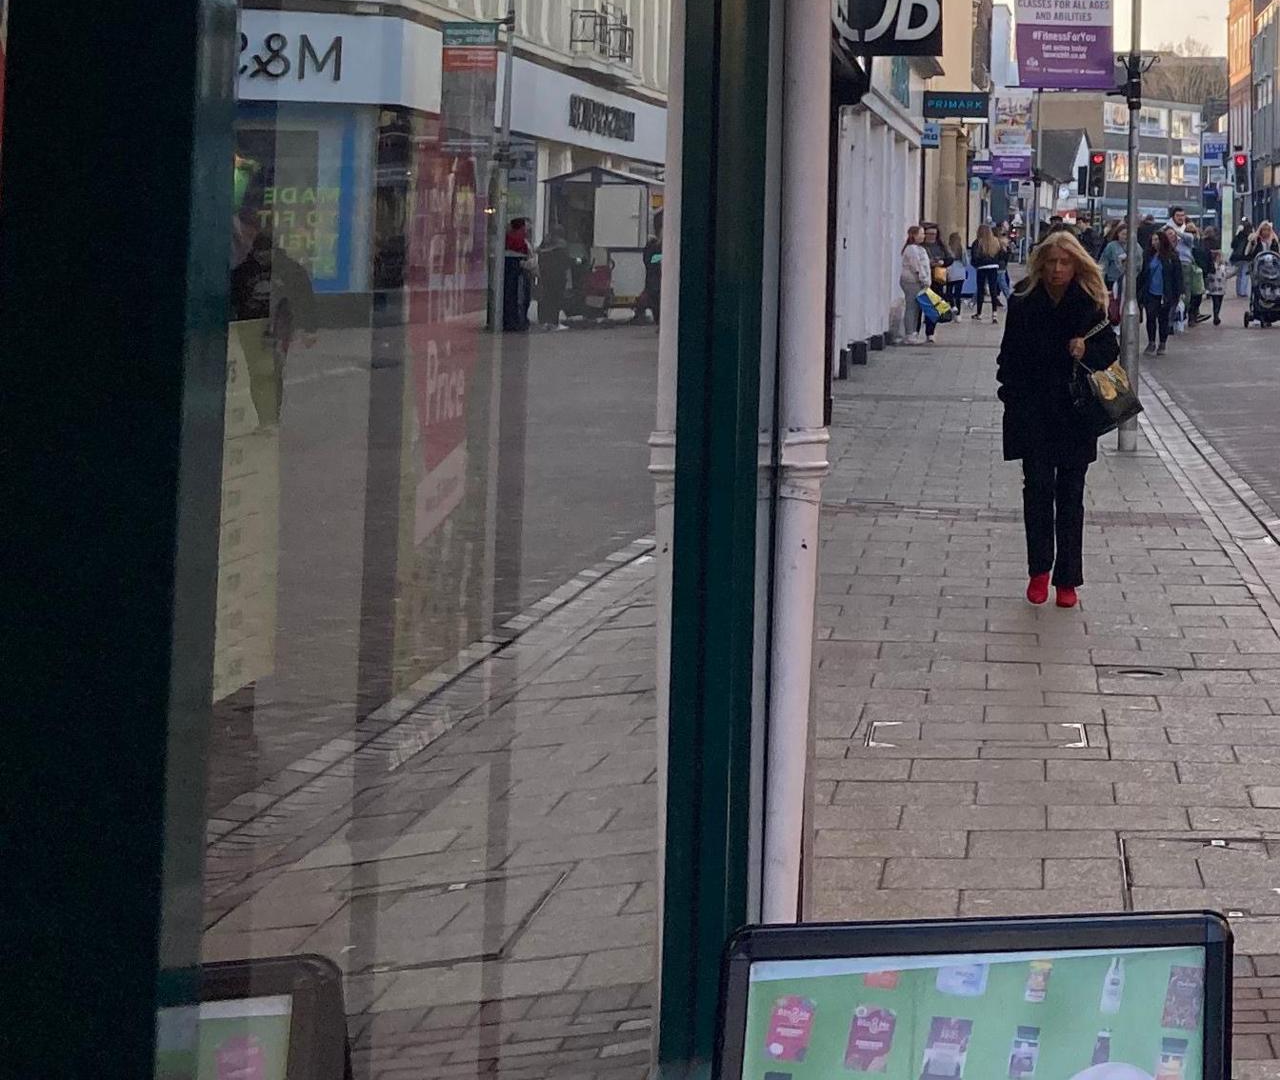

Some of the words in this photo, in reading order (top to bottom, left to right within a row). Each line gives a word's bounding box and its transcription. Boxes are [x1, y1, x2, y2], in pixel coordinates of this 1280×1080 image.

[1018, 0, 1052, 9] CLASSES
[1054, 0, 1071, 9] FOR
[1073, 0, 1087, 10] ALL
[1089, 1, 1110, 10] AGES
[1035, 11, 1051, 21] AND
[1054, 11, 1093, 22] ABILITIES
[927, 99, 983, 110] PRIMARK
[425, 339, 465, 427] Price
